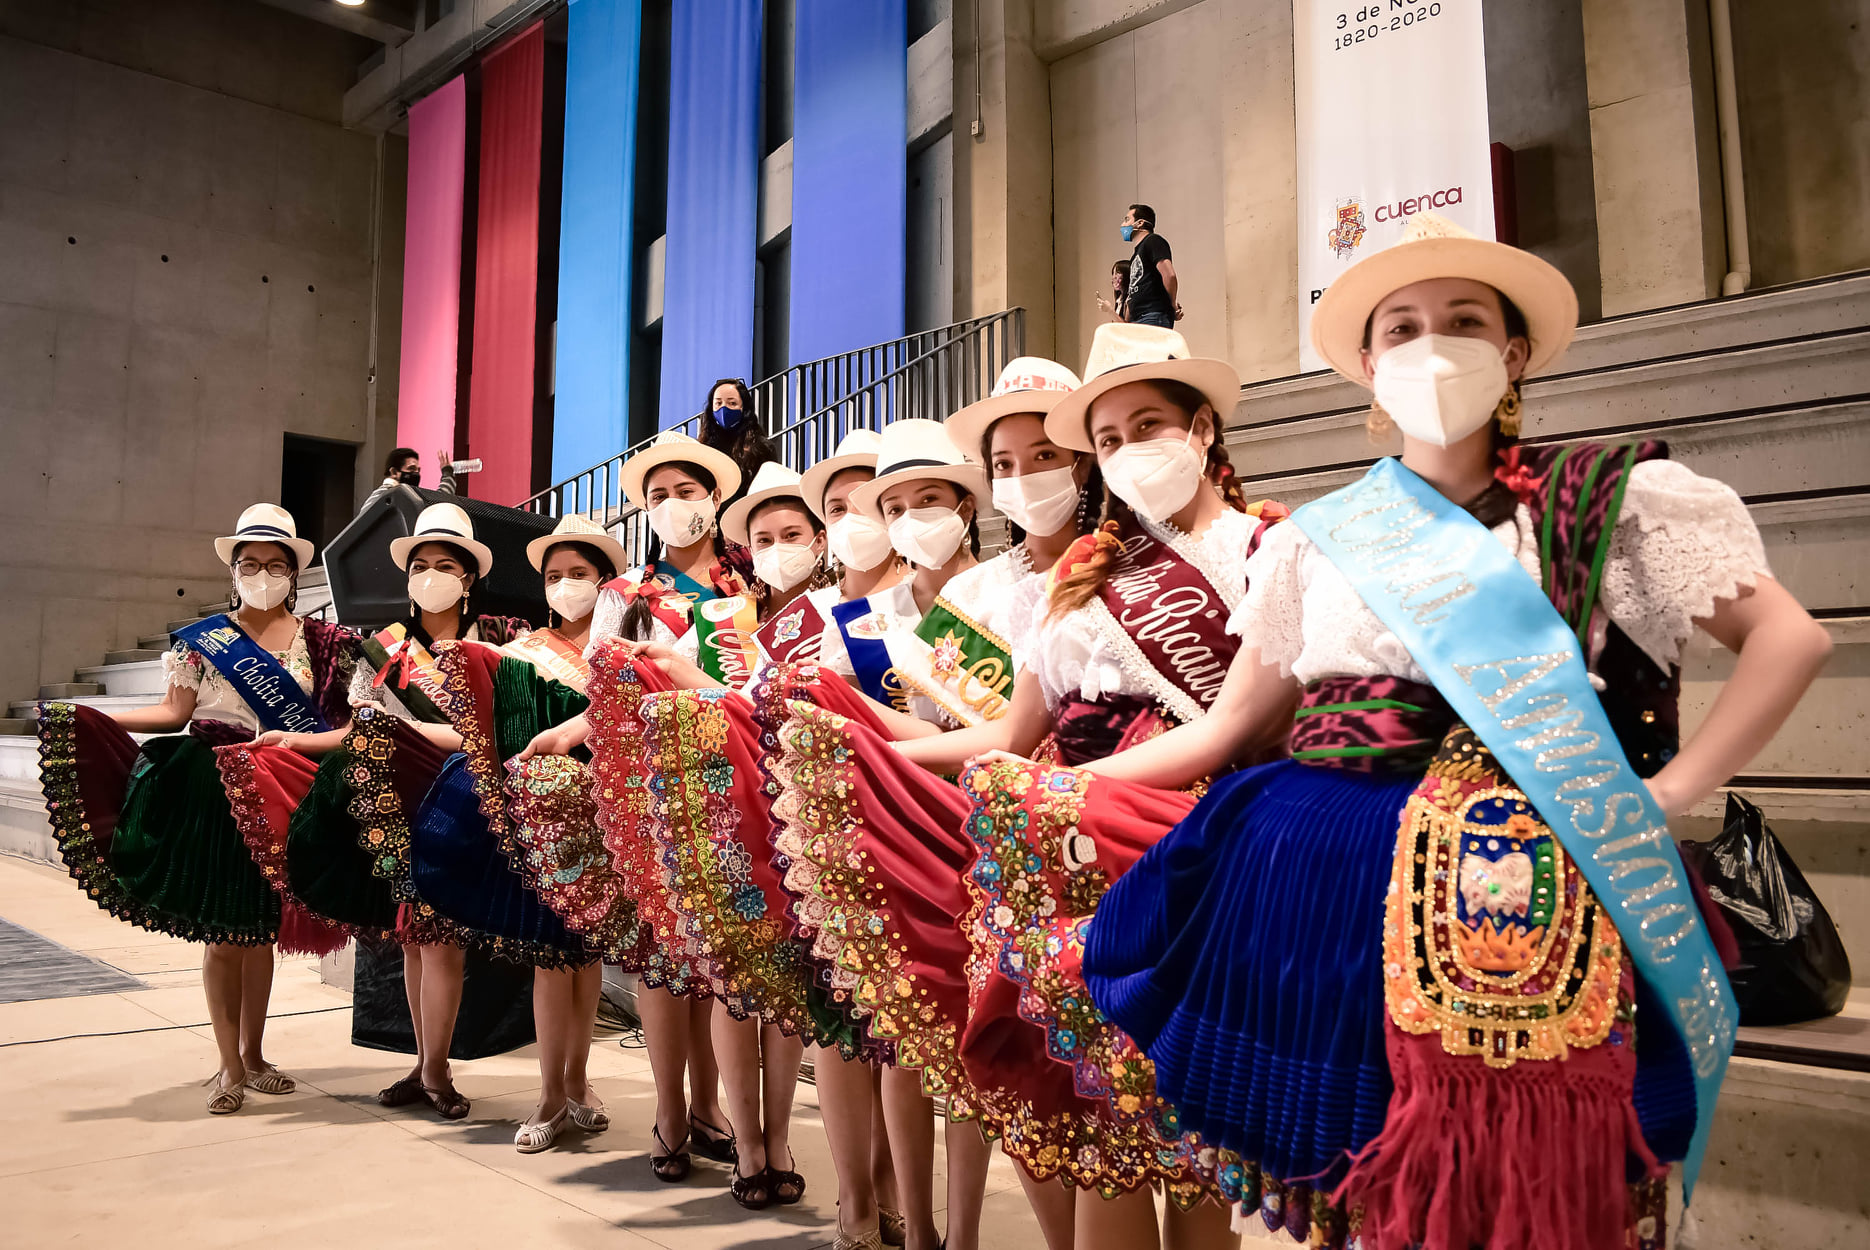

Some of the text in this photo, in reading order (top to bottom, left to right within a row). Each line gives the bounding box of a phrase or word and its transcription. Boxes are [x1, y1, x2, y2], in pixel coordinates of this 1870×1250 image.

[1335, 2, 1441, 51] 1820-2020
[1336, 14, 1347, 29] 3
[1356, 6, 1380, 22] de
[1375, 187, 1462, 222] cuenca
[233, 657, 318, 734] Cholita Vall
